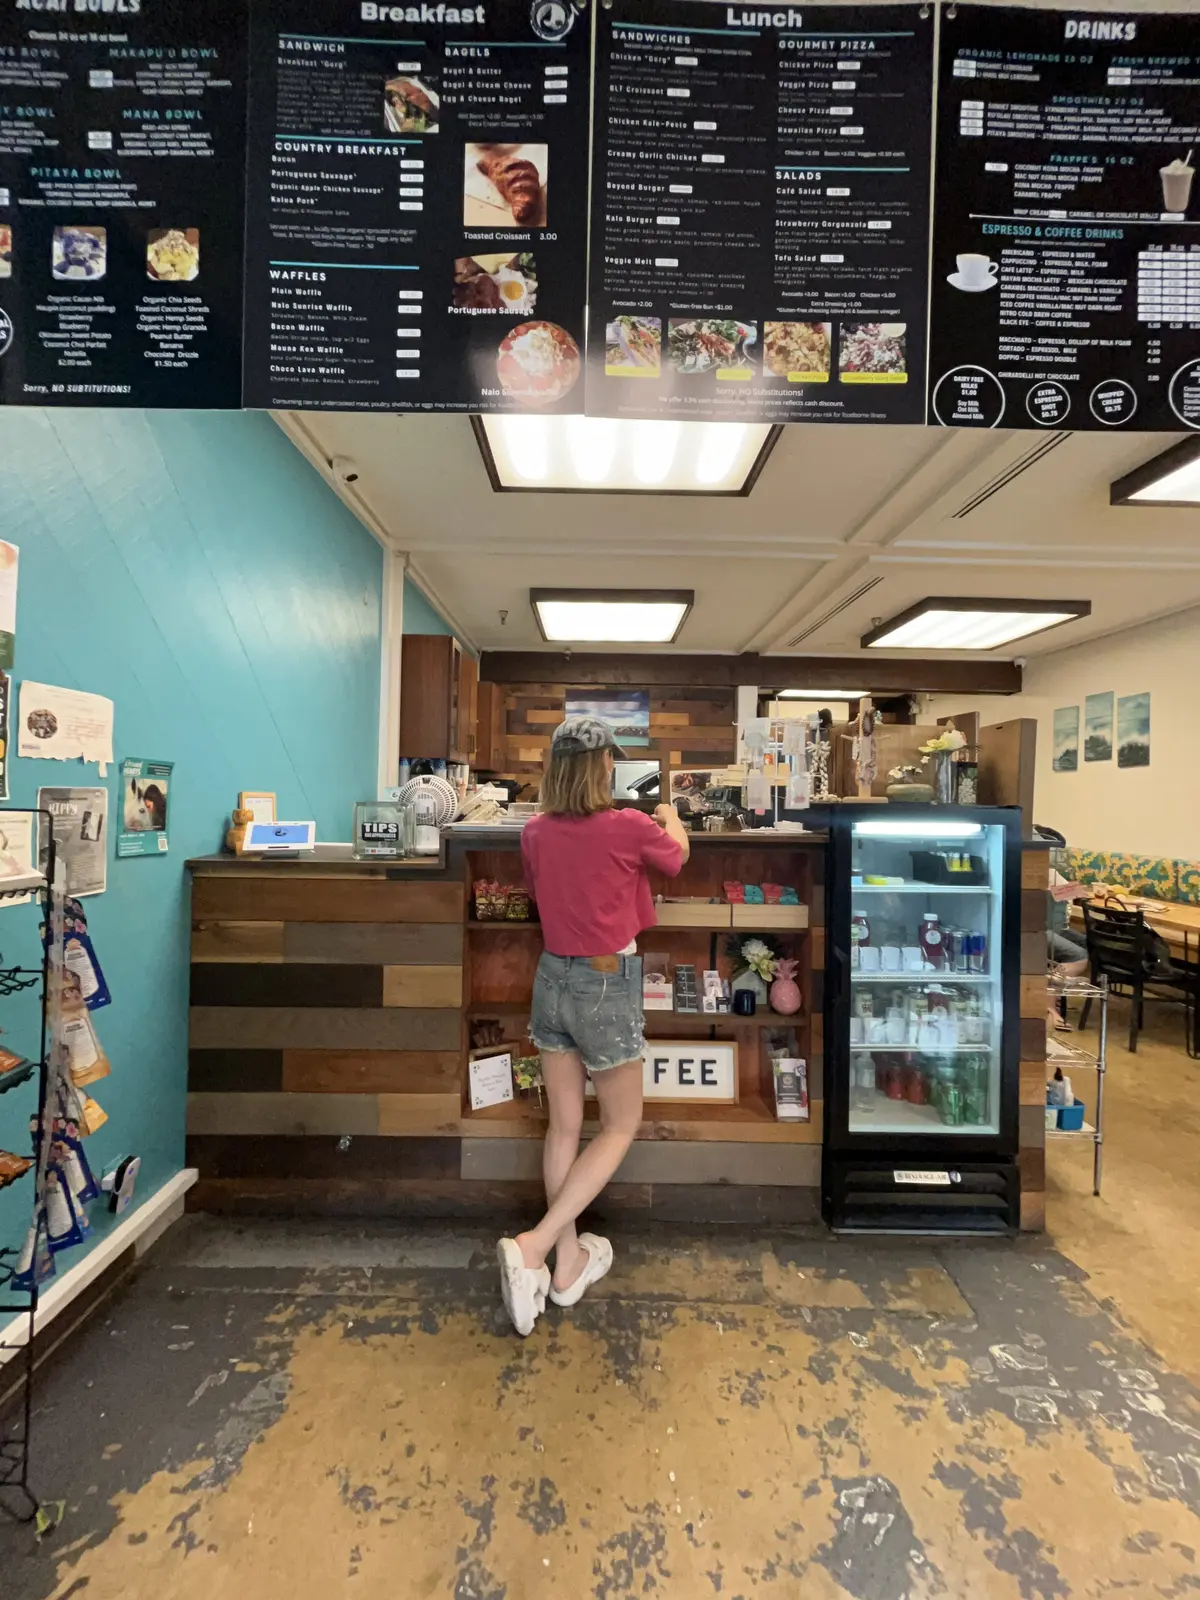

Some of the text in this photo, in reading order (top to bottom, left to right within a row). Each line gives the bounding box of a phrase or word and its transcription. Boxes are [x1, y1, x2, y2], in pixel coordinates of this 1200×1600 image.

[74, 0, 140, 12] BOWLS
[361, 2, 485, 24] Breakfast
[727, 8, 802, 27] Lunch
[1064, 20, 1136, 41] DRINKS
[612, 30, 691, 44] SANDWICHES
[278, 40, 346, 52] SANDWICH
[779, 41, 876, 49] GOURMET PIZZA
[181, 48, 219, 58] BOWL
[445, 48, 490, 57] BAGELS
[610, 53, 642, 61] Chicken
[278, 57, 317, 67] Breakfast
[779, 61, 811, 69] Chicken
[779, 81, 806, 89] Veggie
[626, 86, 665, 95] Croissant
[16, 107, 56, 118] BOWL
[123, 109, 203, 120] MANA BOWL
[608, 117, 640, 126] Chicken
[275, 142, 406, 156] COUNTRY BREAKFAST
[271, 155, 296, 163] Bacon
[608, 150, 698, 161] Creamy Garlic Chicken
[30, 167, 122, 179] PITAYA BOWL
[271, 169, 317, 179] Portuguese
[776, 172, 822, 180] SALADS
[271, 182, 298, 192] Organic
[301, 184, 320, 193] Apple
[323, 185, 350, 193] Chicken
[606, 182, 665, 193] Beyond Burger
[626, 215, 653, 223] Burger
[775, 220, 866, 228] Strawberry Gorgonzola
[463, 232, 494, 240] Toasted
[982, 224, 1124, 239] ESPRESSO & COFFEE DRINKS
[605, 256, 632, 265] Veggie
[269, 270, 327, 281] WAFFLES
[271, 287, 322, 296] Plain Waffle
[293, 302, 323, 311] Sunrise
[448, 306, 534, 316] Portuguese Sausage
[271, 323, 325, 332] Bacon Waffle
[270, 344, 297, 352] Mauna
[317, 346, 344, 354] Waffle
[270, 365, 295, 373] Choco
[318, 367, 345, 375] Waffle
[23, 384, 131, 393] Sorry, NO SUBTITUTIONS!
[481, 388, 500, 396] Nalo
[716, 387, 737, 396] Sorry,
[753, 388, 804, 397] Substitutions!
[1034, 395, 1063, 404] ESPRESSO
[363, 823, 398, 833] TIPS
[643, 1057, 718, 1085] FEE
